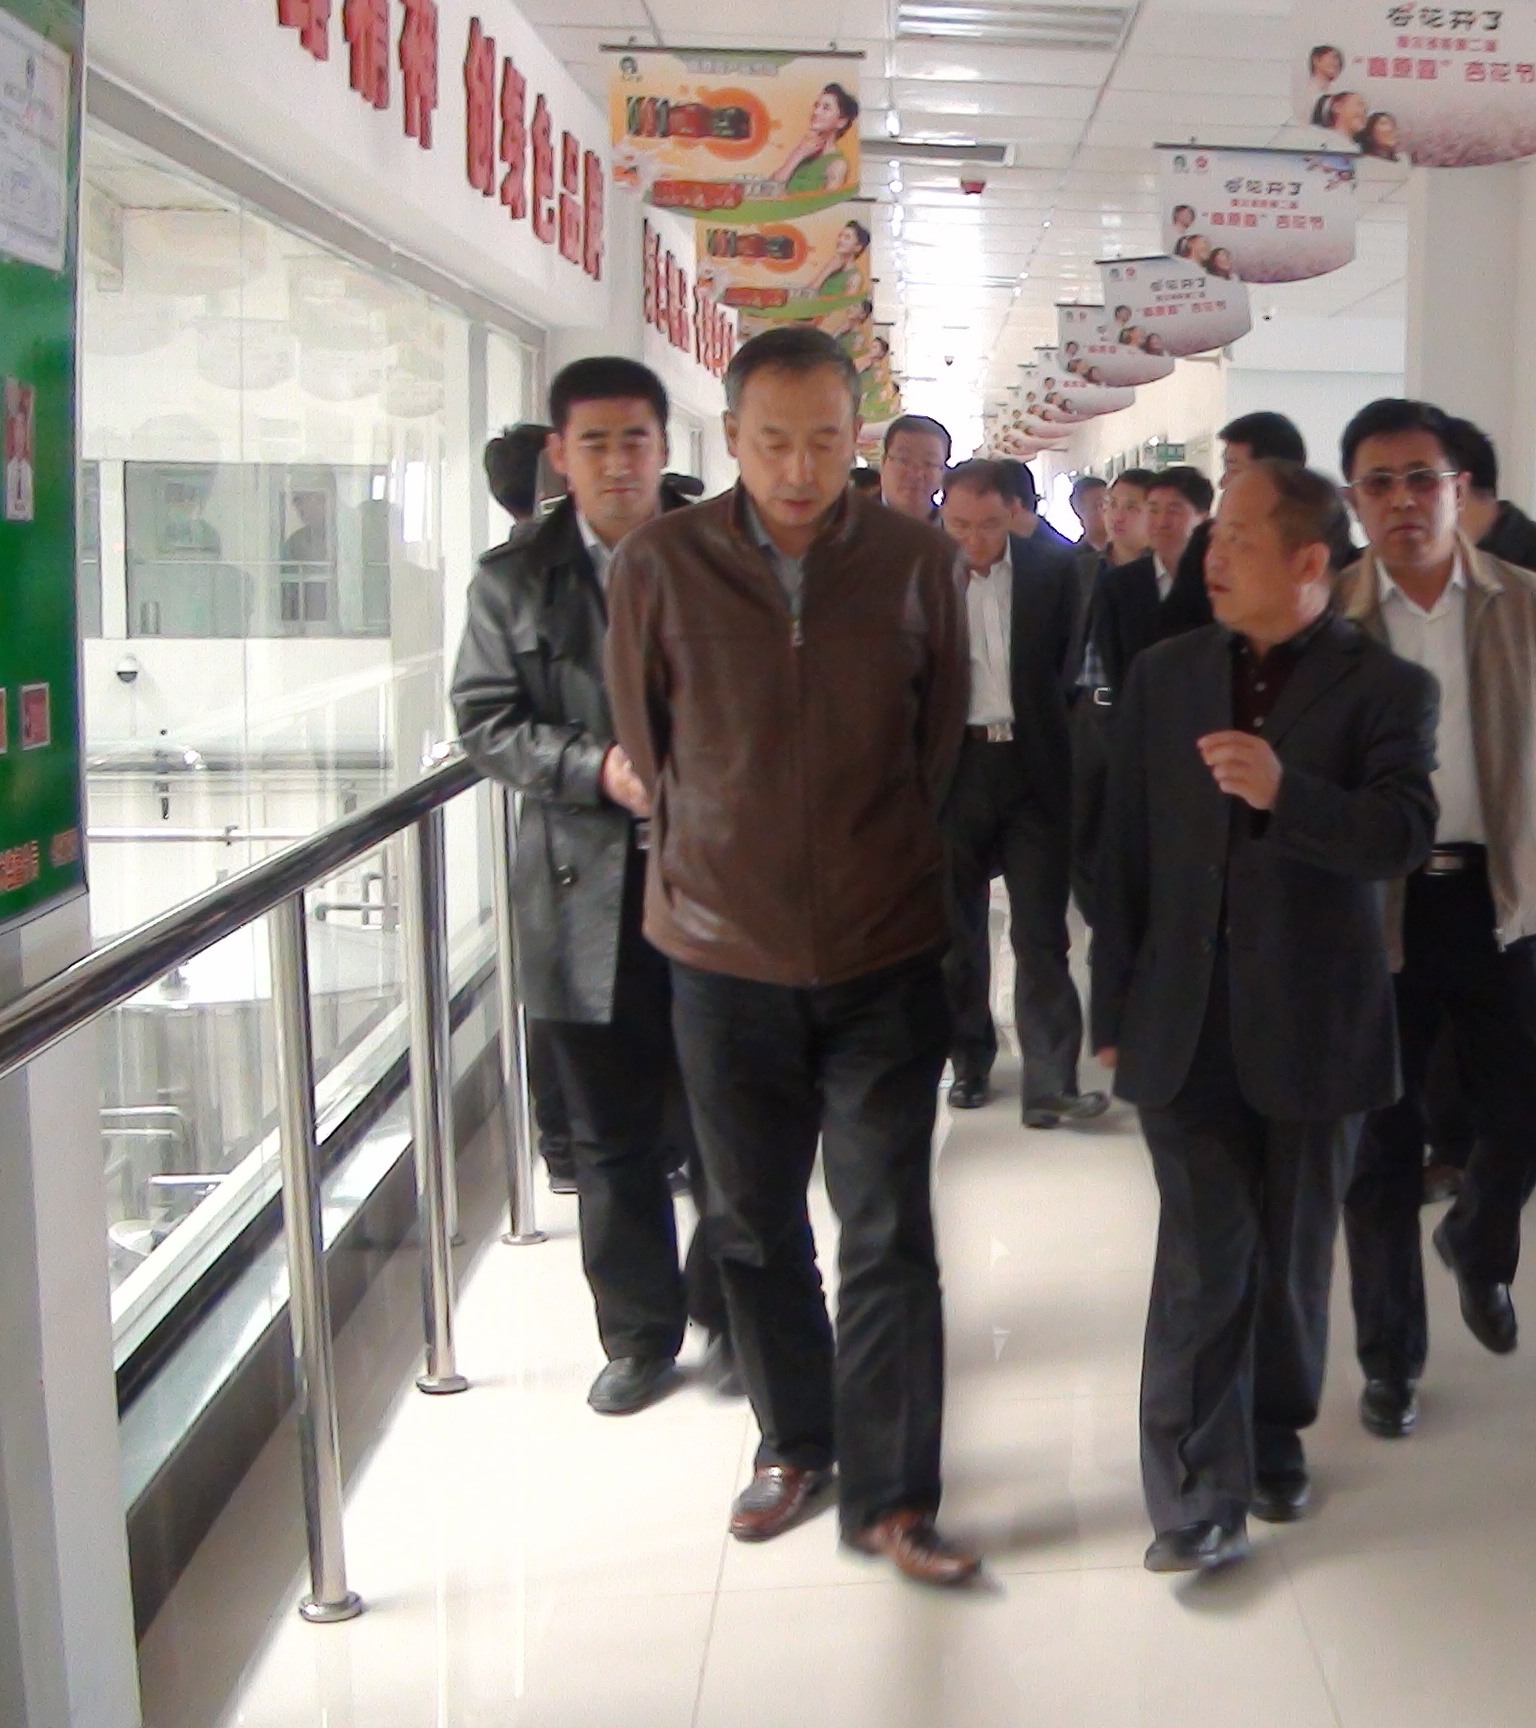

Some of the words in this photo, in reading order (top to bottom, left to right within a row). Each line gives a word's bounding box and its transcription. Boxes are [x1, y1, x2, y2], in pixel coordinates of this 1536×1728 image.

[464, 16, 604, 281] 创绿色品牌
